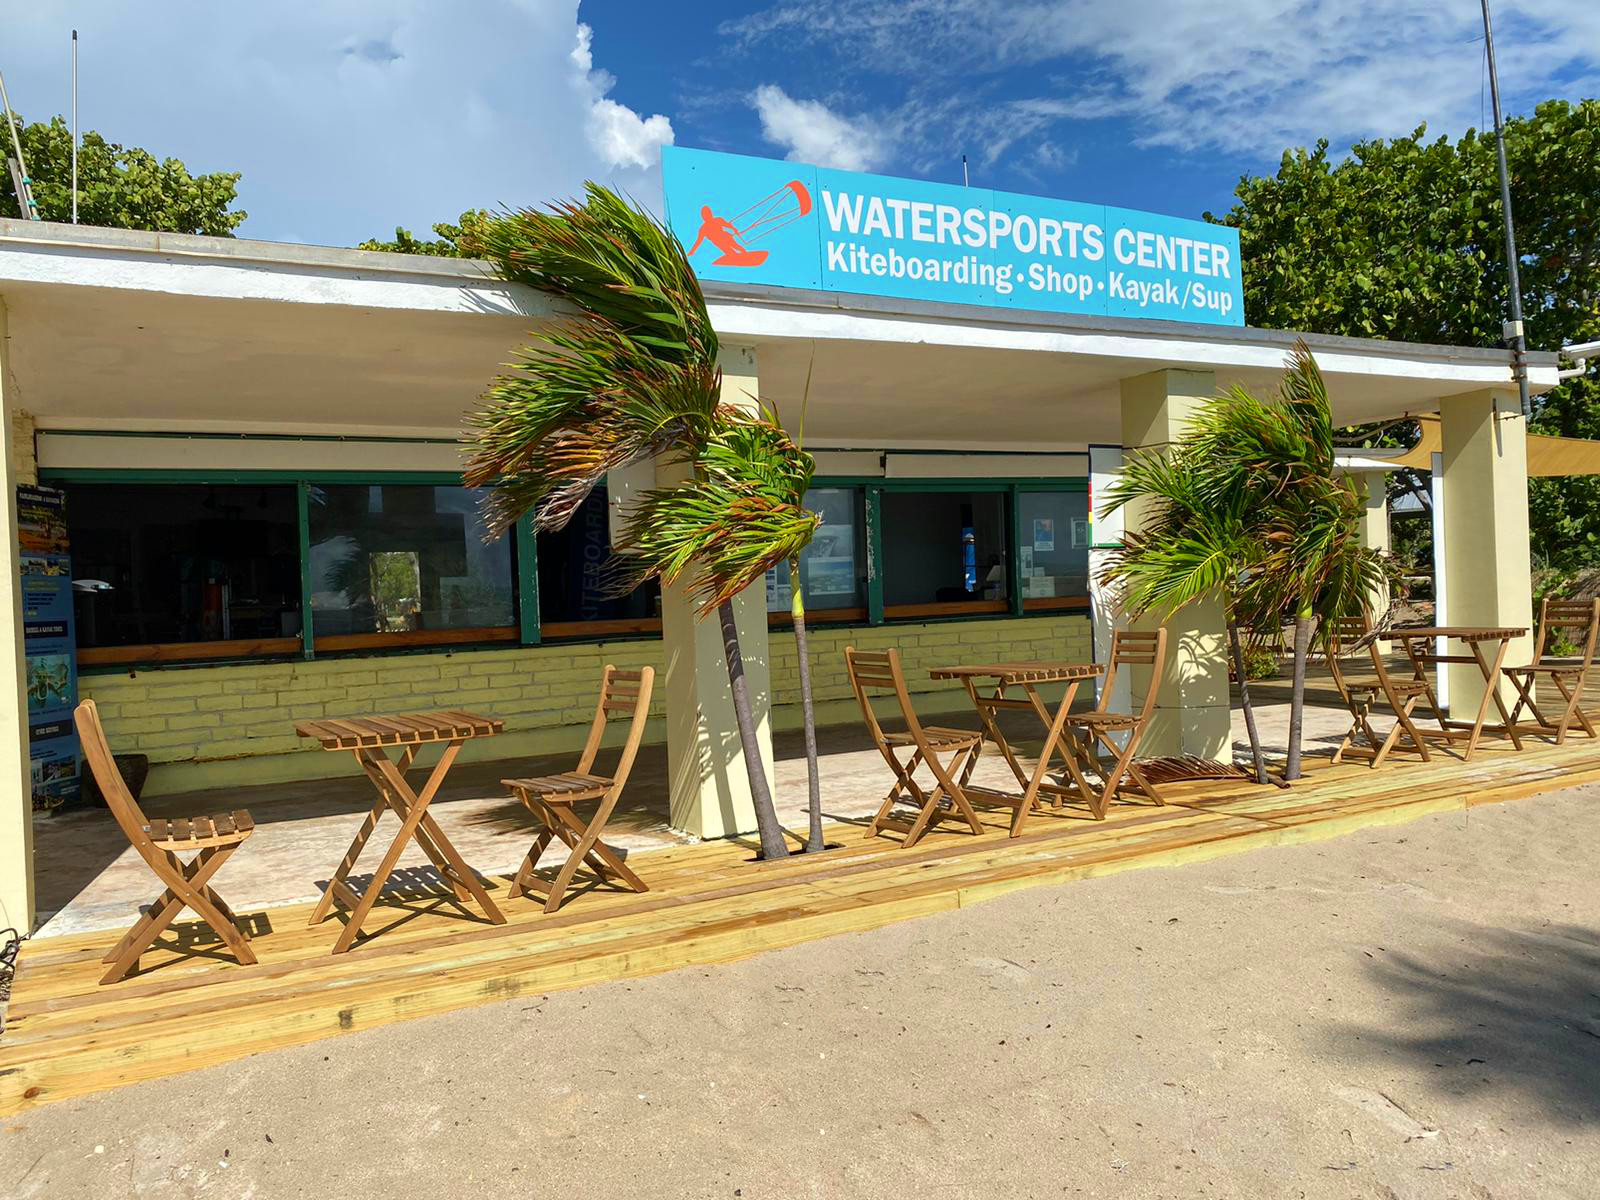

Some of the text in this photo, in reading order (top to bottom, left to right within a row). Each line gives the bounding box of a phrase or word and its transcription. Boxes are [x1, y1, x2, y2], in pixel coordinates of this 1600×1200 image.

[821, 190, 1231, 279] WATERSPORTS CENTER
[827, 241, 1013, 294] Kiteboarding
[1028, 263, 1093, 300] Shop
